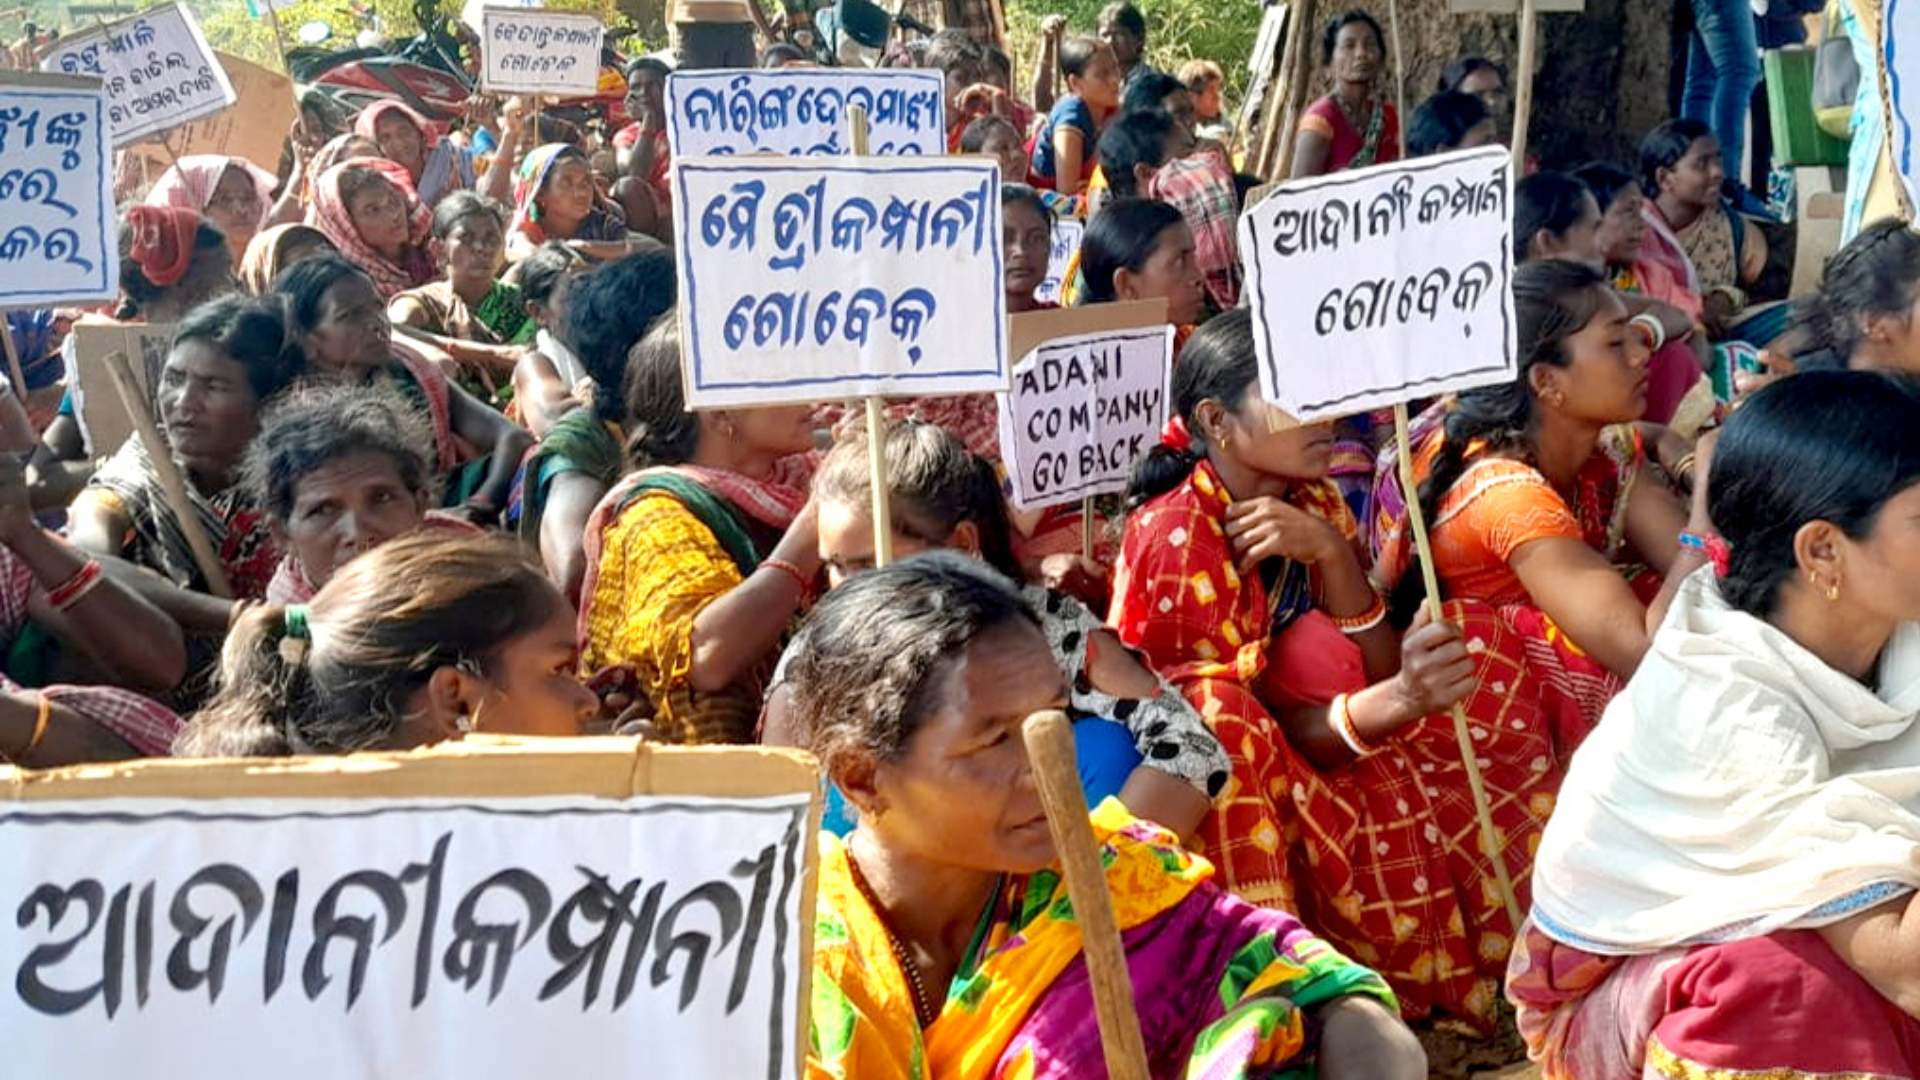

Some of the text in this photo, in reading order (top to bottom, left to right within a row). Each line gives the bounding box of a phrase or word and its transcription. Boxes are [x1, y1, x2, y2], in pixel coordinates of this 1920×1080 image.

[1020, 345, 1122, 396] ADANI
[1027, 388, 1159, 442] COMPANY
[1033, 433, 1144, 492] GO BACK
